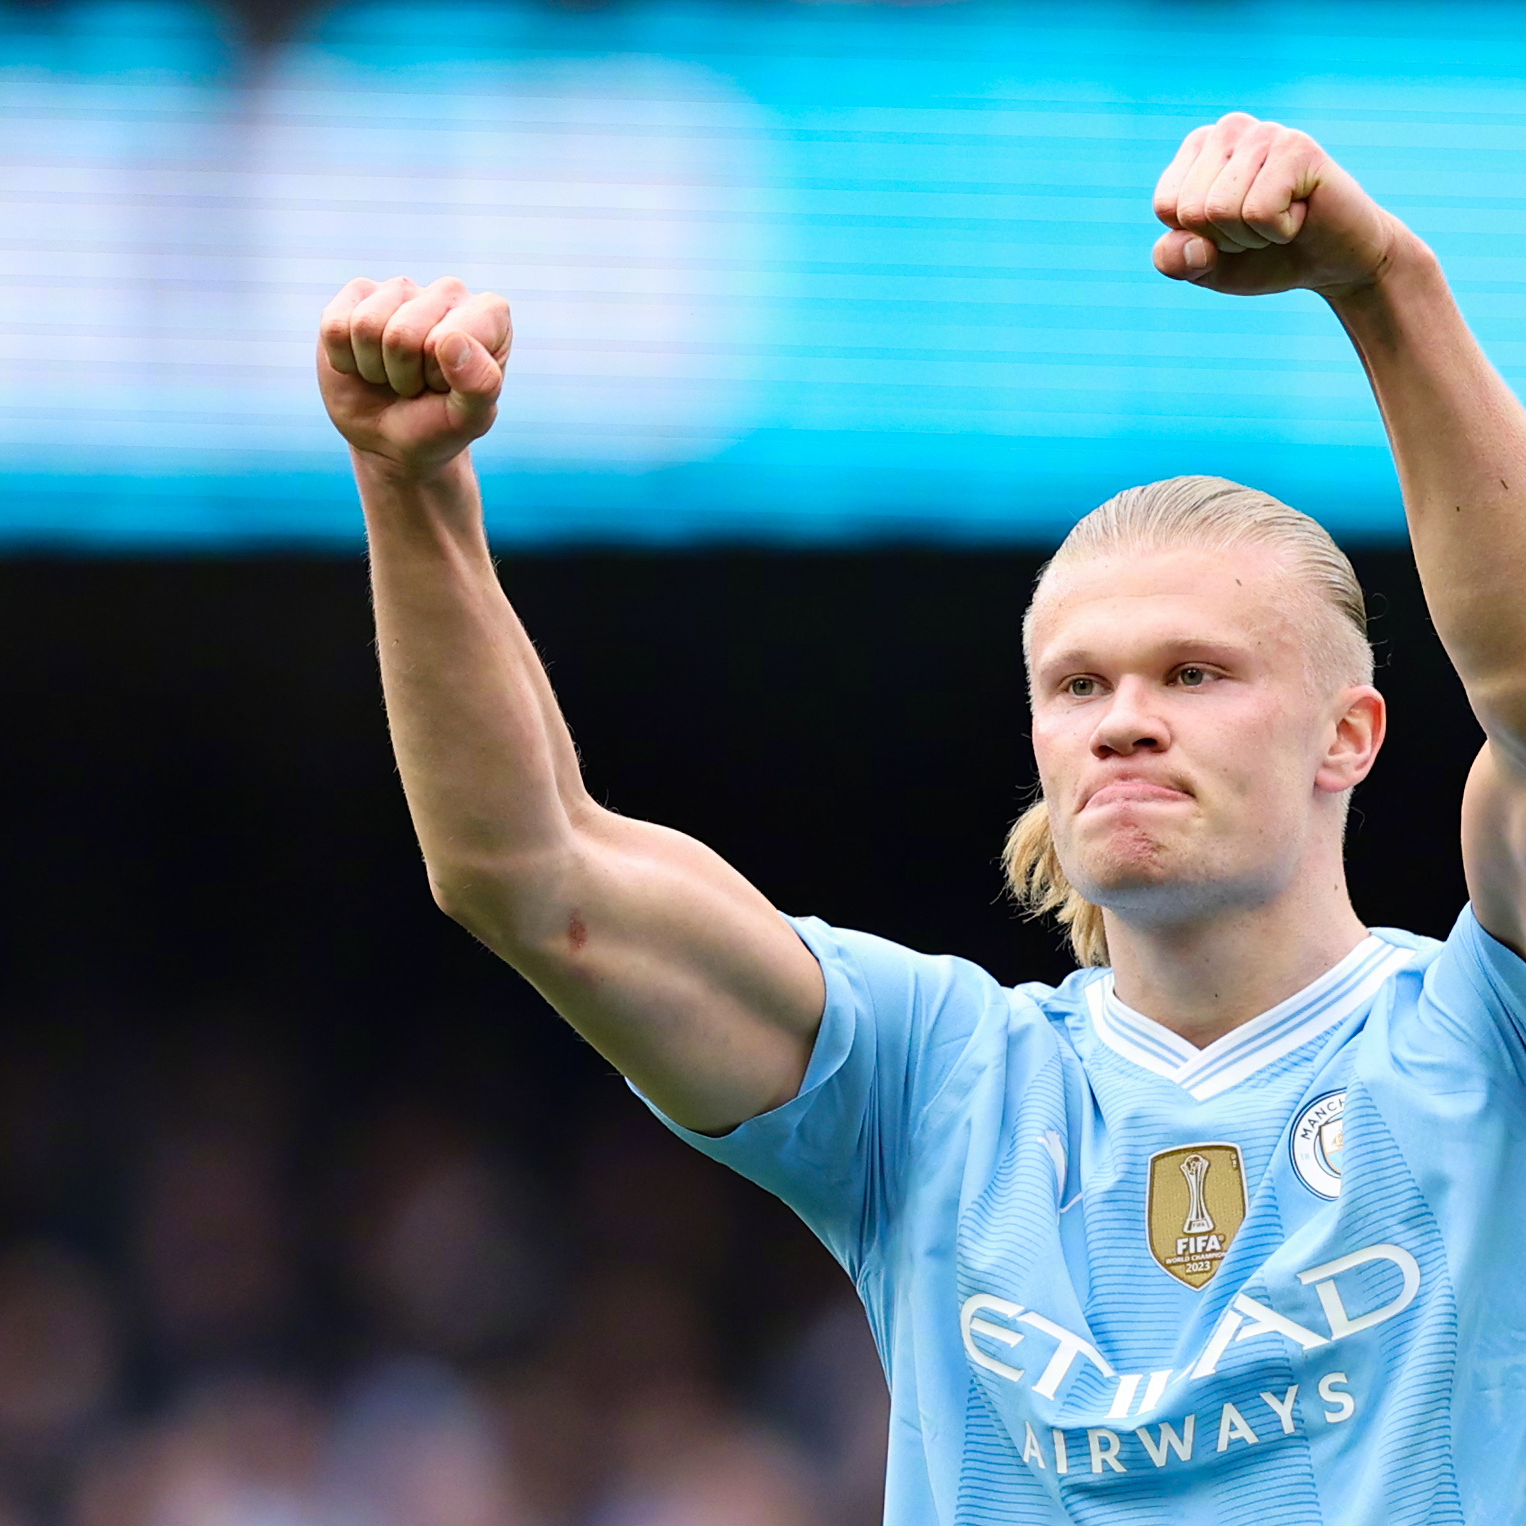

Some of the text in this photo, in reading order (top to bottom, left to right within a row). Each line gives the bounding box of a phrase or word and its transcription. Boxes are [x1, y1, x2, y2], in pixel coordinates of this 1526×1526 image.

[1177, 1234, 1221, 1255] FIFA
[1165, 1255, 1190, 1264] WORLD
[1186, 1260, 1211, 1272] 2023
[1022, 1372, 1356, 1474] AIRWAYS
